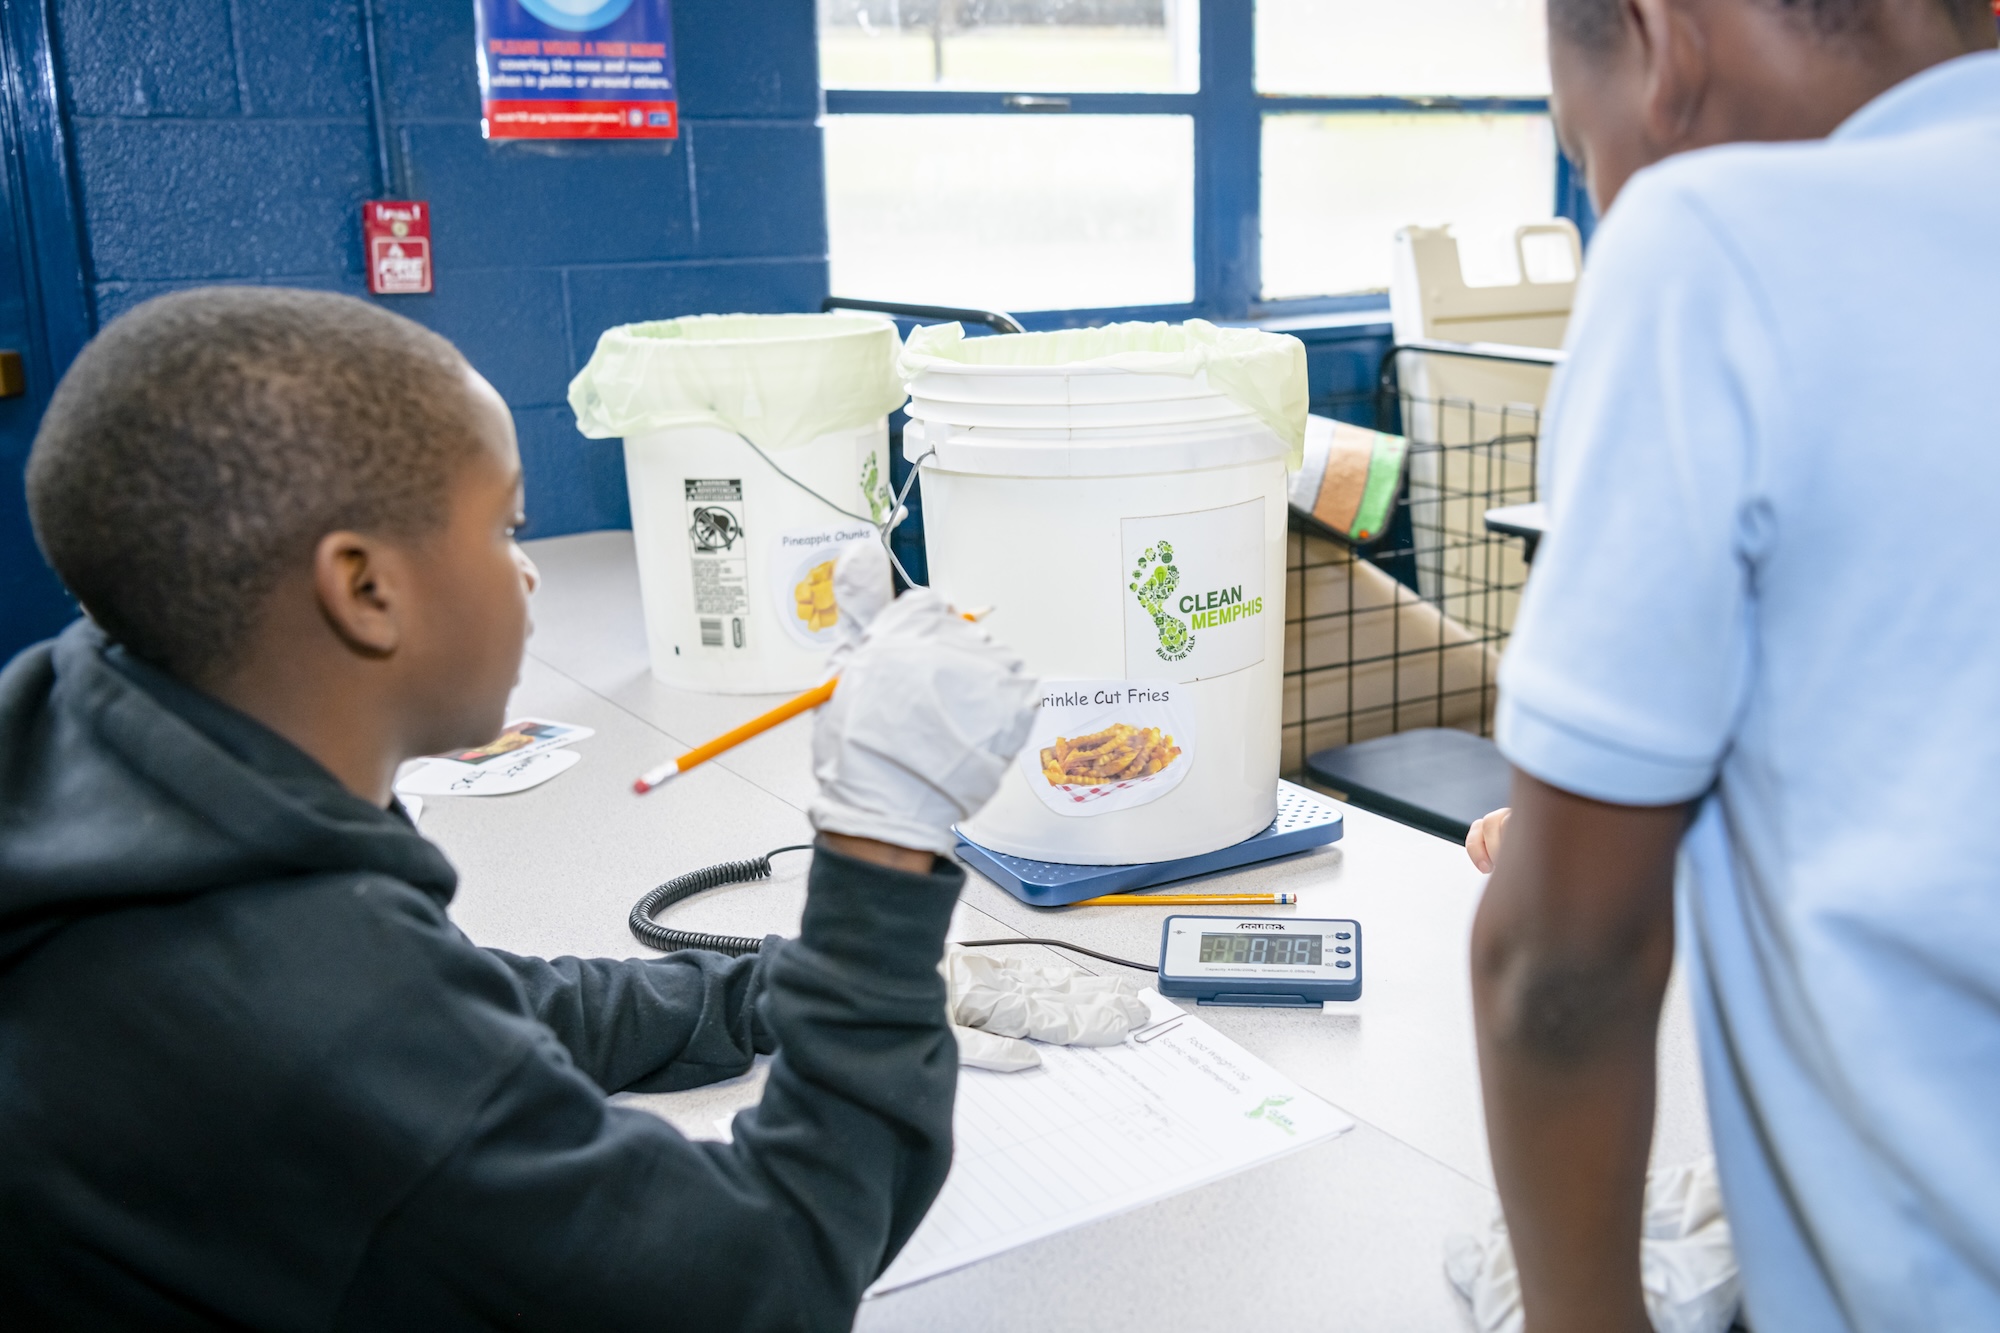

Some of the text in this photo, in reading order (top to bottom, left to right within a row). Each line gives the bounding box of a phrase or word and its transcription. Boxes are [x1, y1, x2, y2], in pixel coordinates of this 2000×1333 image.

[782, 528, 871, 547] Pineapple Chunks
[1179, 585, 1242, 614] CLEAN
[1191, 597, 1263, 630] MEMPHIS
[1155, 634, 1196, 662] WALK THE TALK
[1042, 688, 1170, 708] rinkle Cut Fries
[1187, 1036, 1209, 1052] Food
